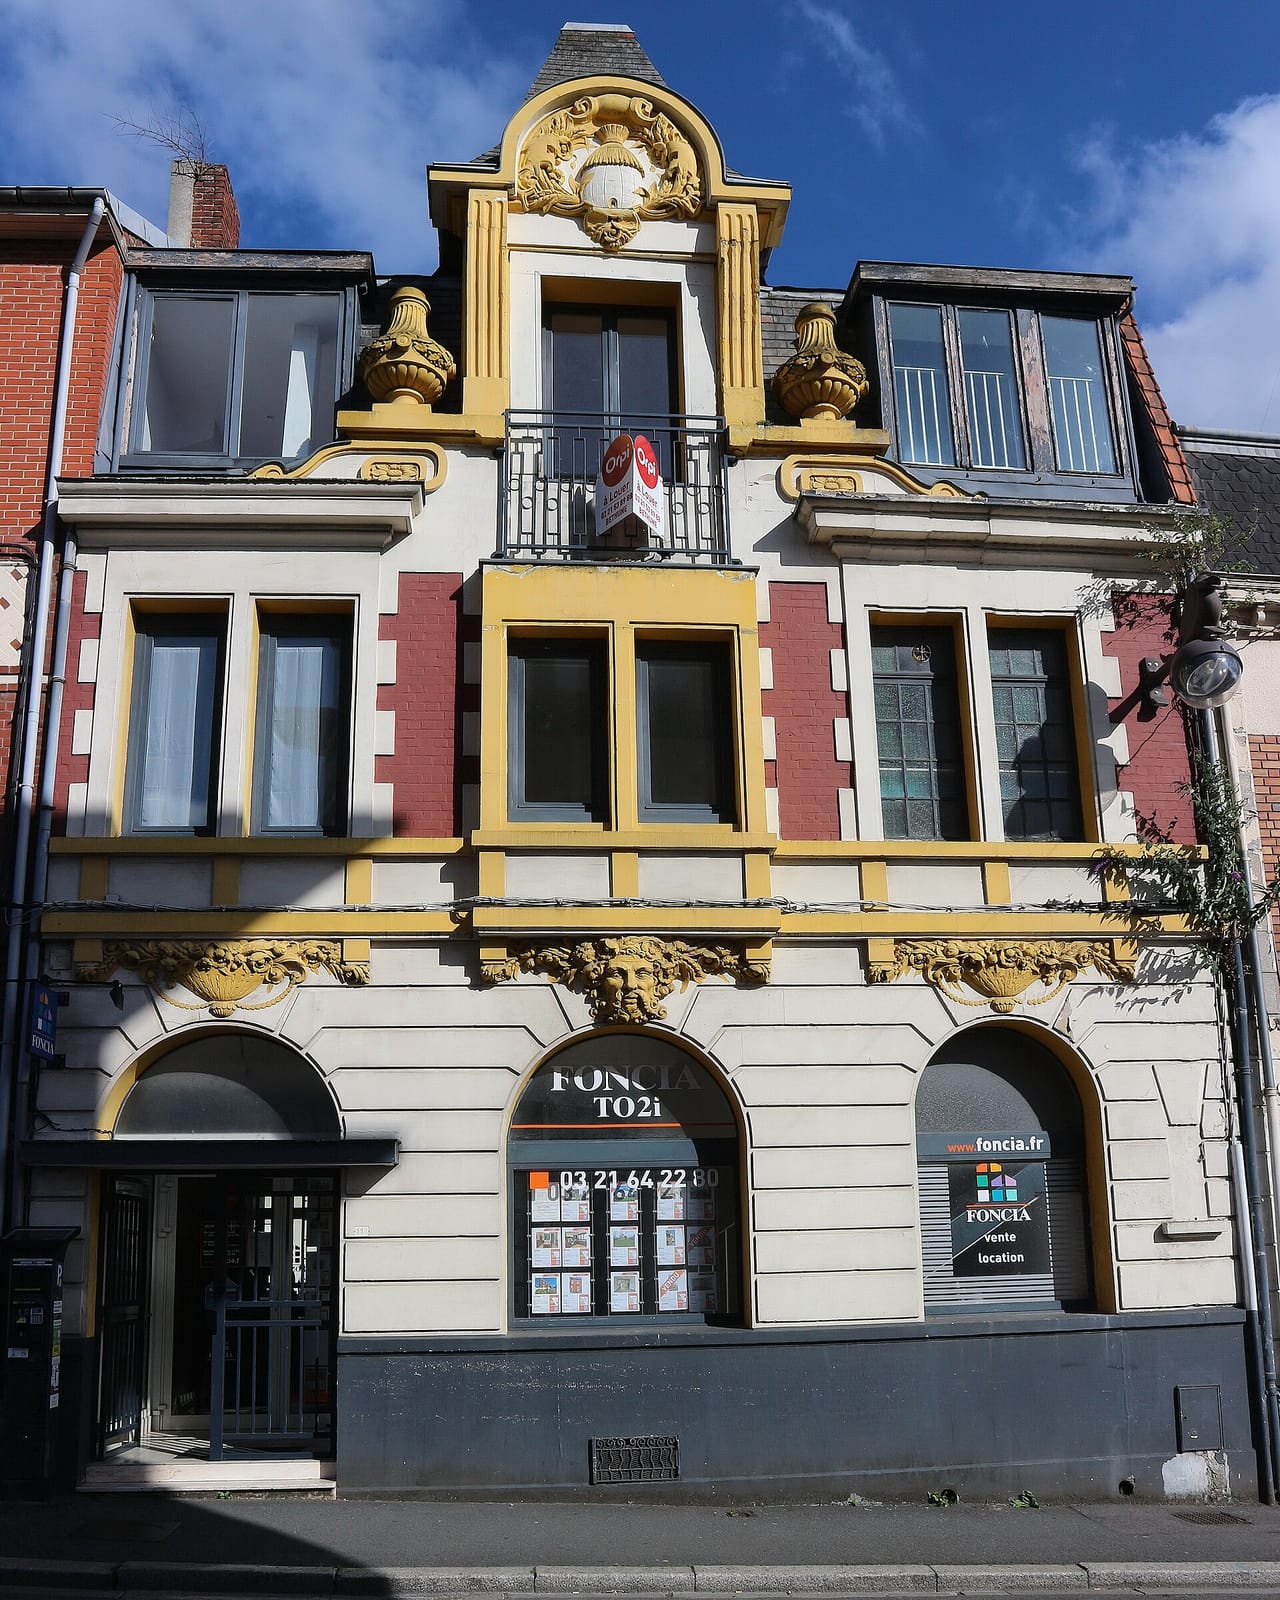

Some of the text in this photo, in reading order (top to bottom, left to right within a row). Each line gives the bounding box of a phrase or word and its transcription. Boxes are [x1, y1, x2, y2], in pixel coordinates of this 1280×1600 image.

[605, 443, 630, 474] Orpi
[637, 447, 656, 477] Orpi
[609, 481, 630, 502] Louer
[31, 1034, 55, 1055] FONCIA
[550, 1065, 701, 1092] FONCIA
[593, 1096, 663, 1118] TO2i
[947, 1136, 1044, 1152] www.foncia.fr
[560, 1168, 719, 1190] 03 21 64 22 80
[966, 1208, 1032, 1223] FONCIA
[984, 1232, 1017, 1243] vente
[978, 1252, 1025, 1264] location
